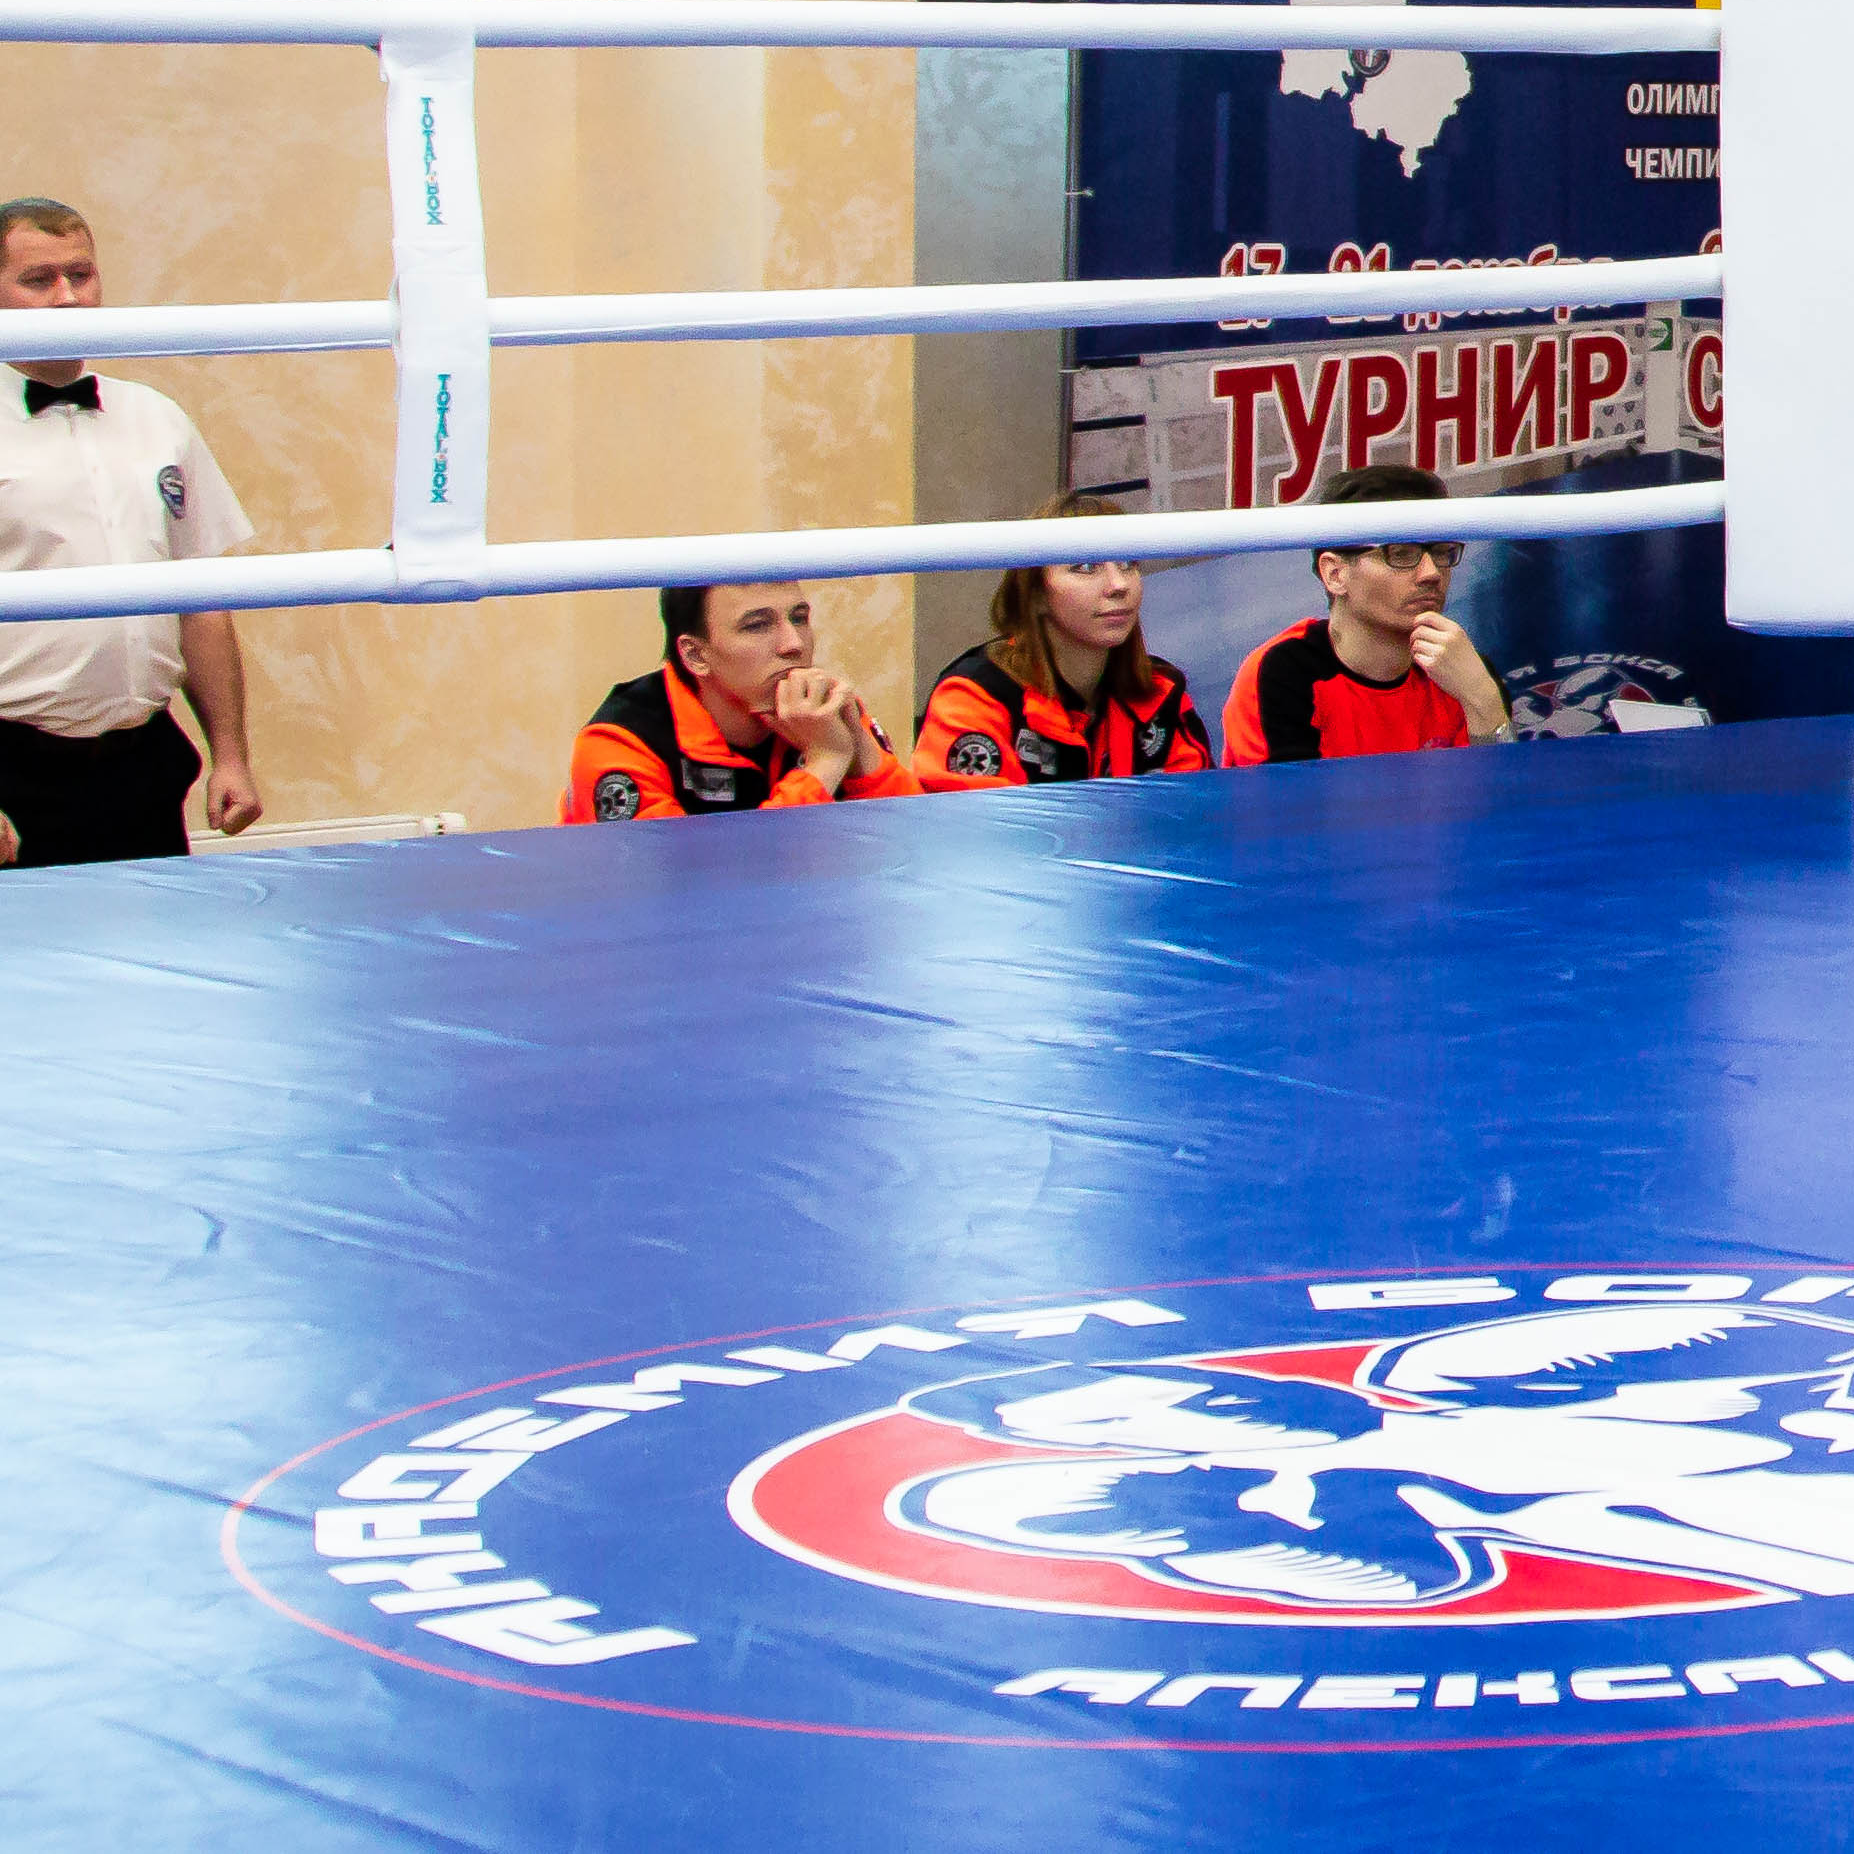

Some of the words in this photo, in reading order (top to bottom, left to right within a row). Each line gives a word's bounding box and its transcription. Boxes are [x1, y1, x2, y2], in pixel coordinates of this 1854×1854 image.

[1625, 147, 1720, 179] ЧЕМПИ
[1212, 334, 1630, 510] ТУРНИР
[314, 1298, 1187, 1666] АКАДЕМИЯ
